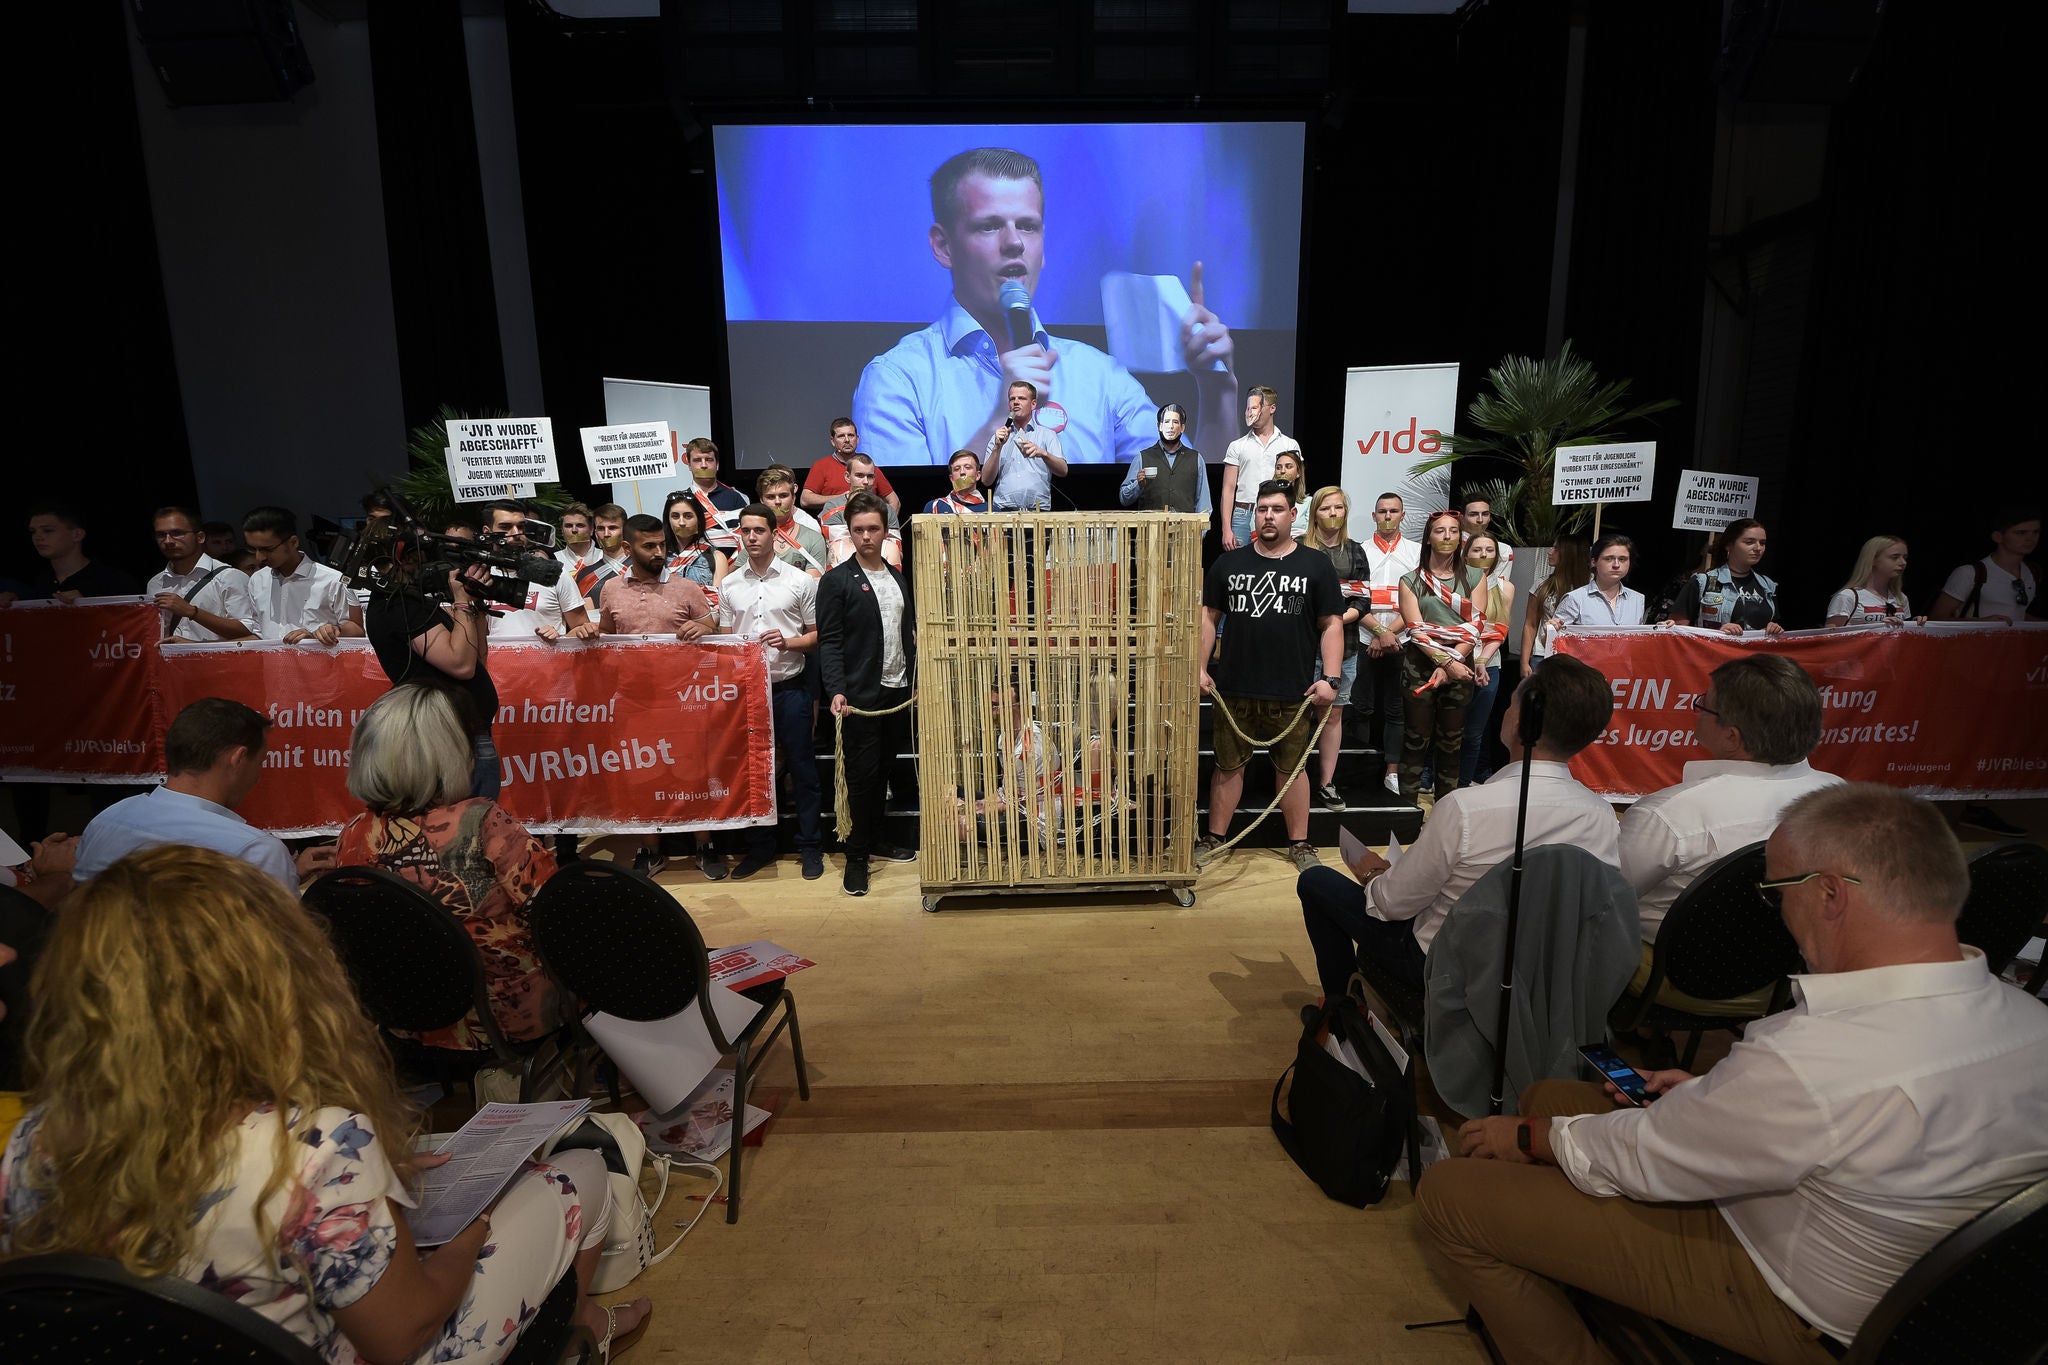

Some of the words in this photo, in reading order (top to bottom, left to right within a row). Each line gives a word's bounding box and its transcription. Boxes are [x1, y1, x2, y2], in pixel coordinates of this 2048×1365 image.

[497, 424, 538, 436] WURDE
[1357, 417, 1442, 455] vida
[505, 455, 533, 466] WURDEN
[533, 454, 547, 465] DER
[627, 455, 641, 463] DER
[642, 452, 668, 462] JUGEND
[1592, 452, 1603, 462] FÜR
[1603, 451, 1637, 461] JUGENDLICHE
[1561, 464, 1583, 473] WURDEN
[1583, 463, 1599, 472] STARK
[467, 469, 493, 480] JUGEND
[1596, 476, 1611, 485] DER
[1613, 475, 1642, 484] JUGEND
[1718, 480, 1749, 493] WURDE
[1716, 507, 1737, 517] WURDEN
[1738, 509, 1748, 518] DER
[1683, 516, 1703, 526] JUGEND
[1704, 518, 1733, 528] WEGGENO
[1227, 573, 1256, 592] SCT
[89, 629, 142, 659] vida
[677, 671, 739, 702] vida
[1611, 678, 1671, 710] EIN
[523, 698, 616, 724] halten!
[680, 702, 707, 713] jugend
[269, 702, 342, 728] falten
[1594, 727, 1620, 745] es
[262, 743, 305, 769] mit
[501, 737, 676, 787] JVRbleibt
[1898, 762, 1952, 774] vidajugend
[668, 787, 730, 802] vidajugend
